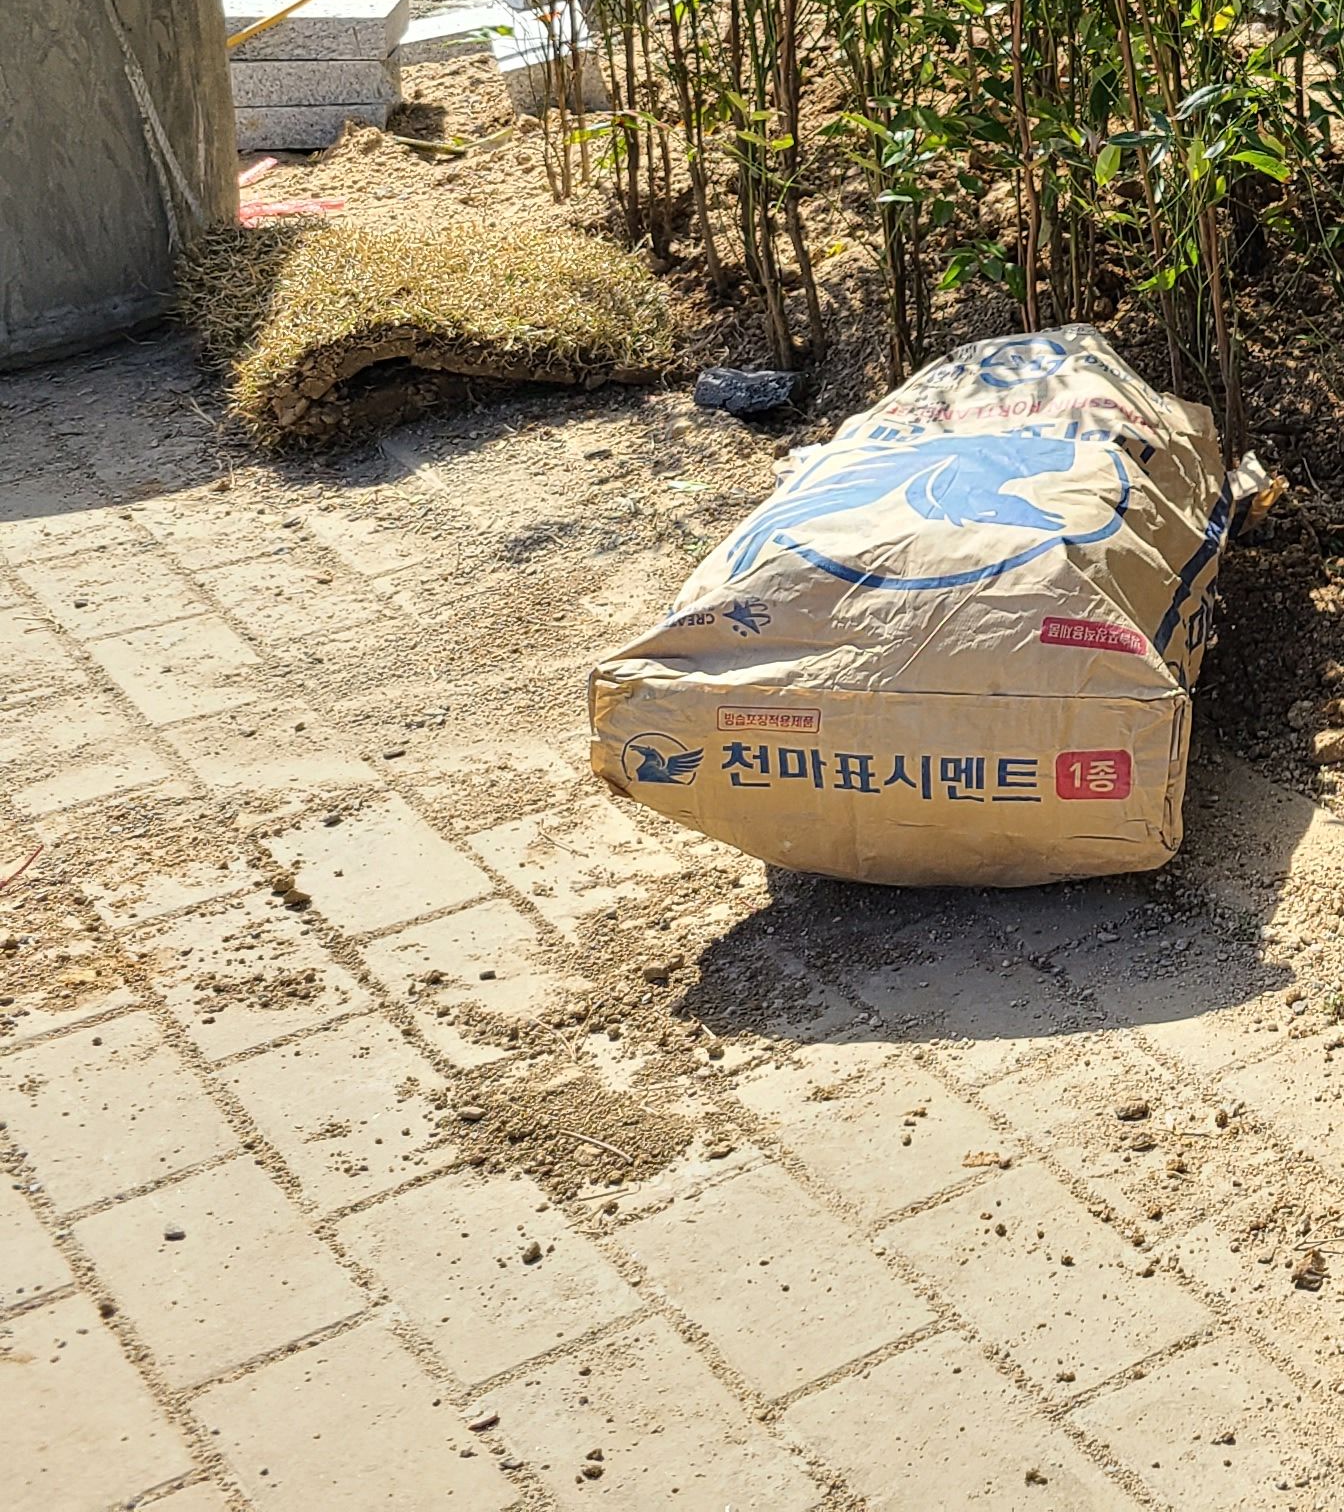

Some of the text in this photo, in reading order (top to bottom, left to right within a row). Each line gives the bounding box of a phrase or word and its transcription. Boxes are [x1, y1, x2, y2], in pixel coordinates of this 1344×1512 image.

[723, 712, 814, 729] 방습포장적용제품
[720, 741, 1118, 803] 천마표시멘트 1종
